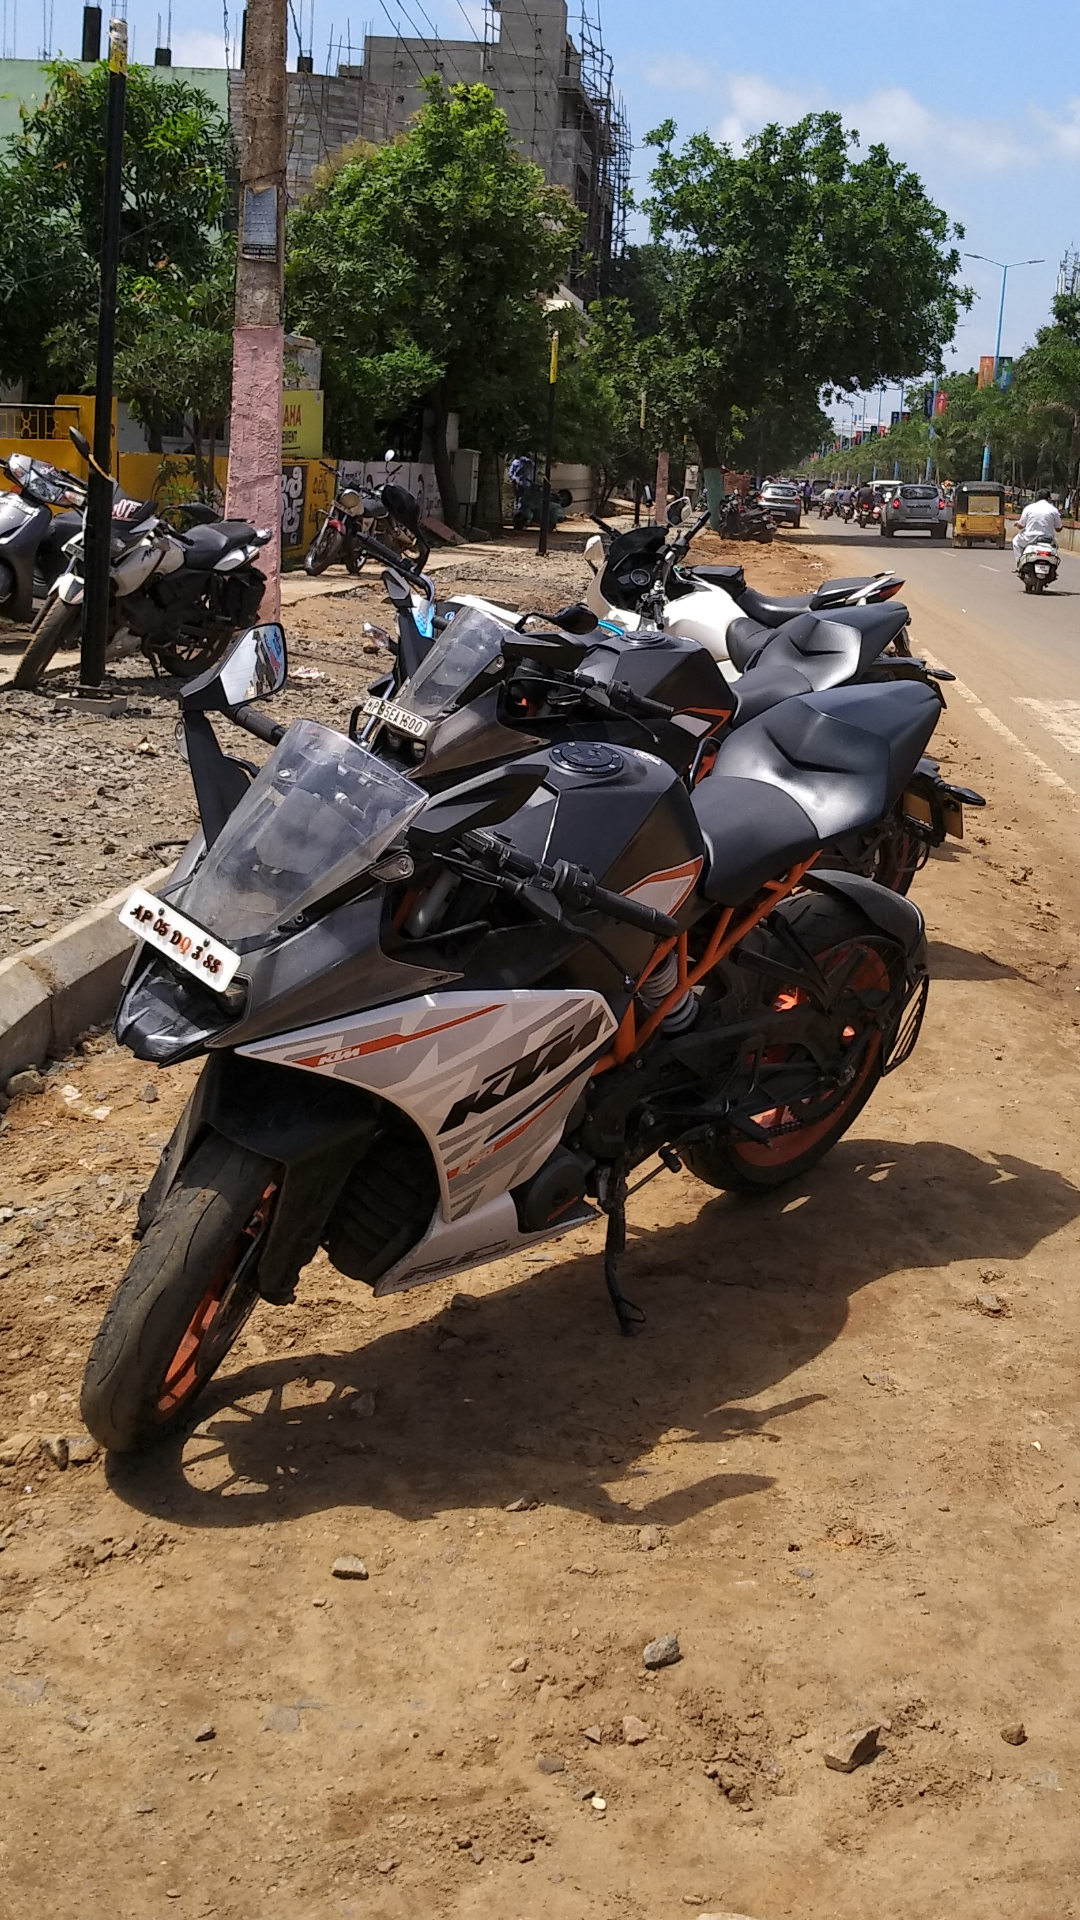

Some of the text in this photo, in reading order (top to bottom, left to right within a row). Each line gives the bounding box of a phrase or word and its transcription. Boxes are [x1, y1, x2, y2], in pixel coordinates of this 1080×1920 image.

[282, 404, 302, 427] AHA
[317, 1046, 361, 1066] KTM
[436, 1010, 605, 1137] KTM
